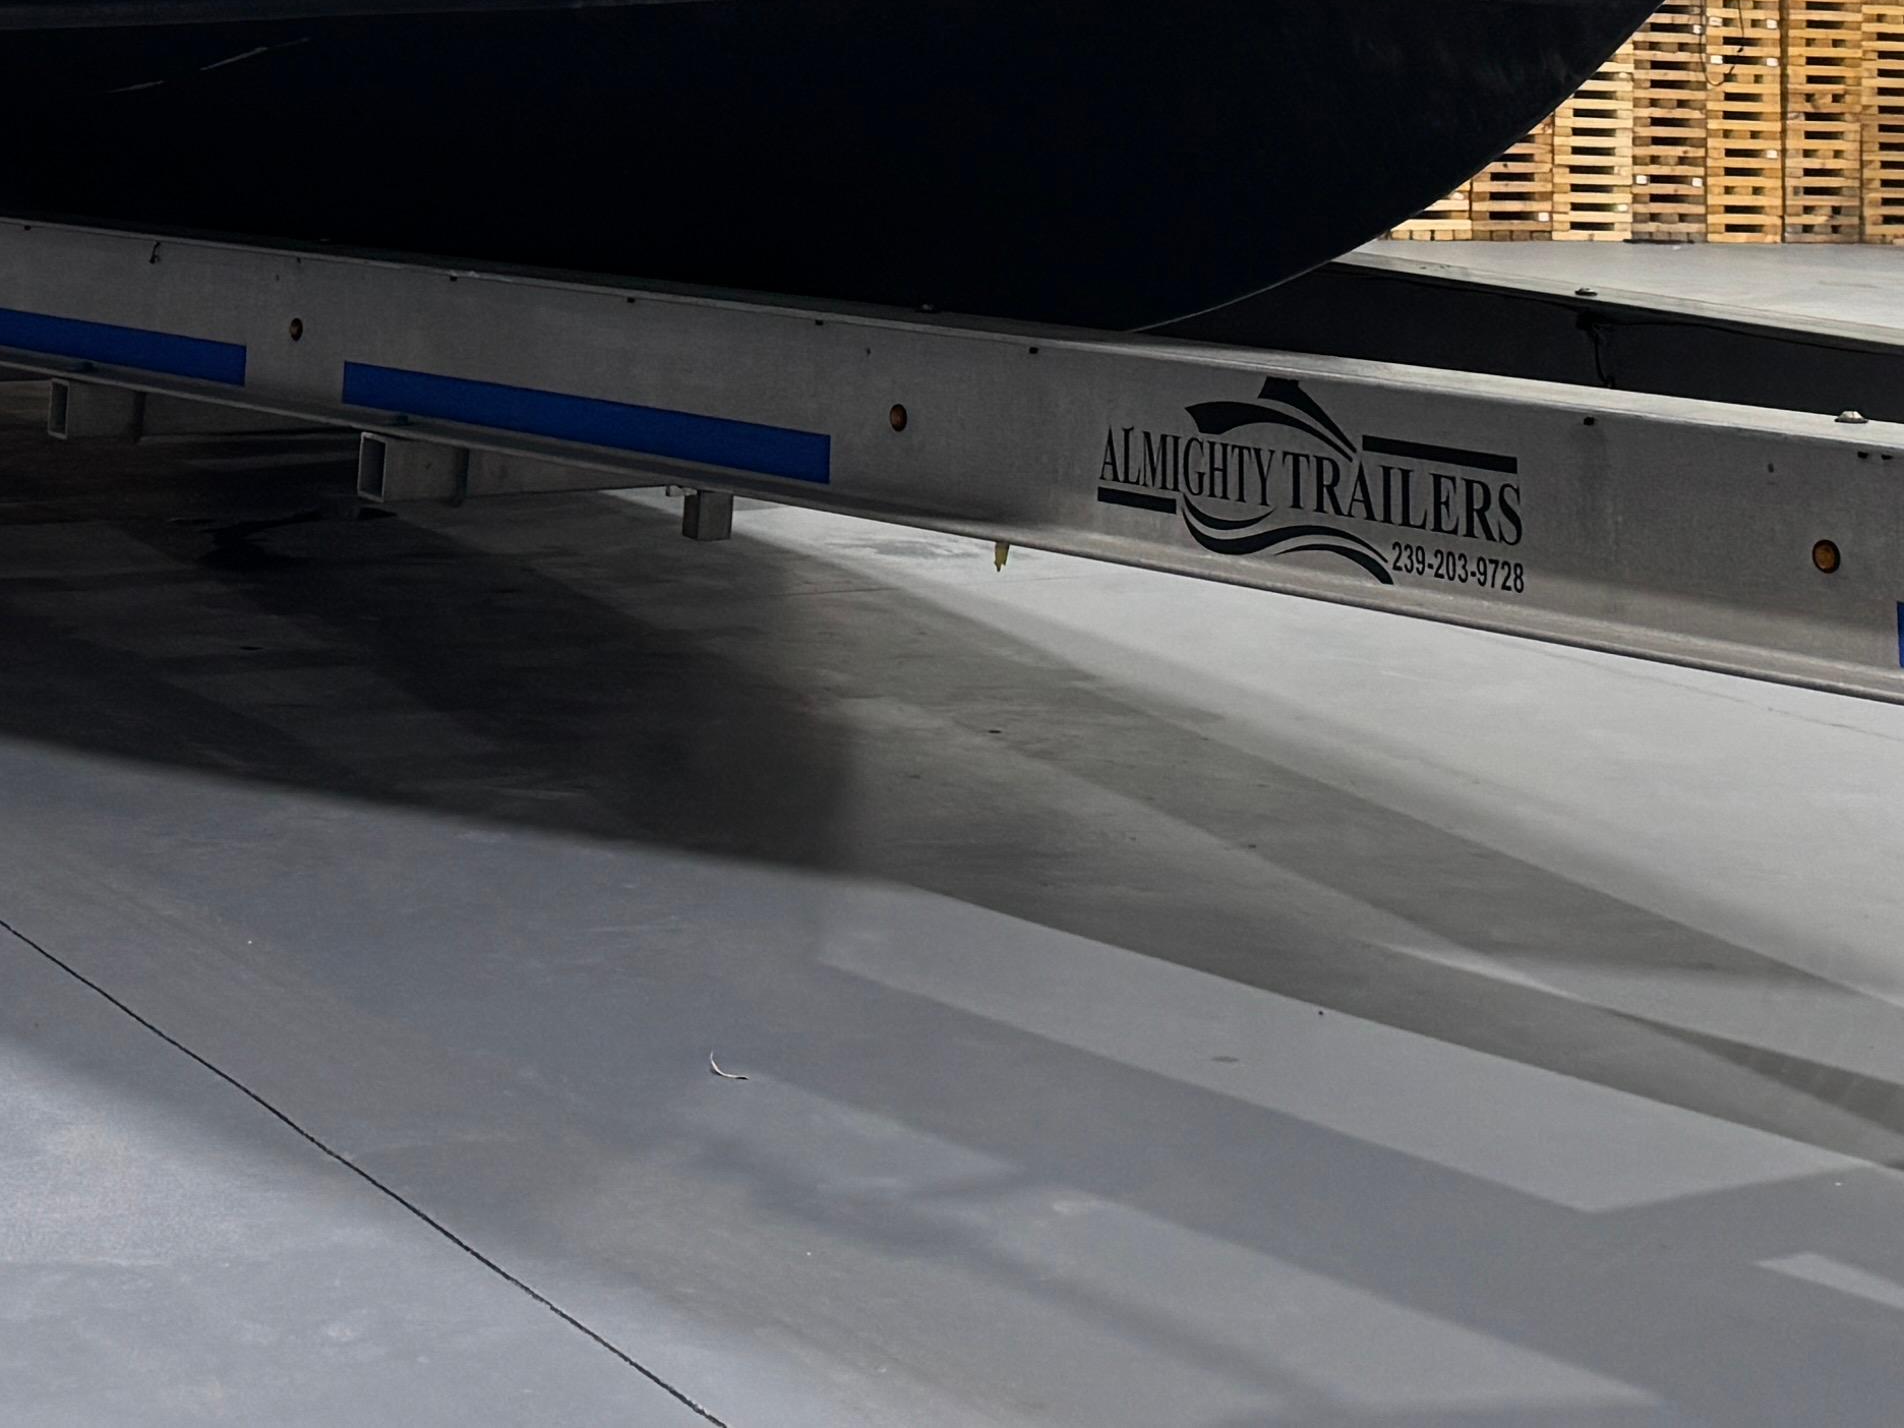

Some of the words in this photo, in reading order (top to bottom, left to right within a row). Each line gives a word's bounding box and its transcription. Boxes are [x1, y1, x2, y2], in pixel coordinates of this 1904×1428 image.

[1098, 424, 1278, 507] ALMIGHTY
[1282, 451, 1523, 546] TRAILERS
[1392, 541, 1526, 594] 239-203-9728
